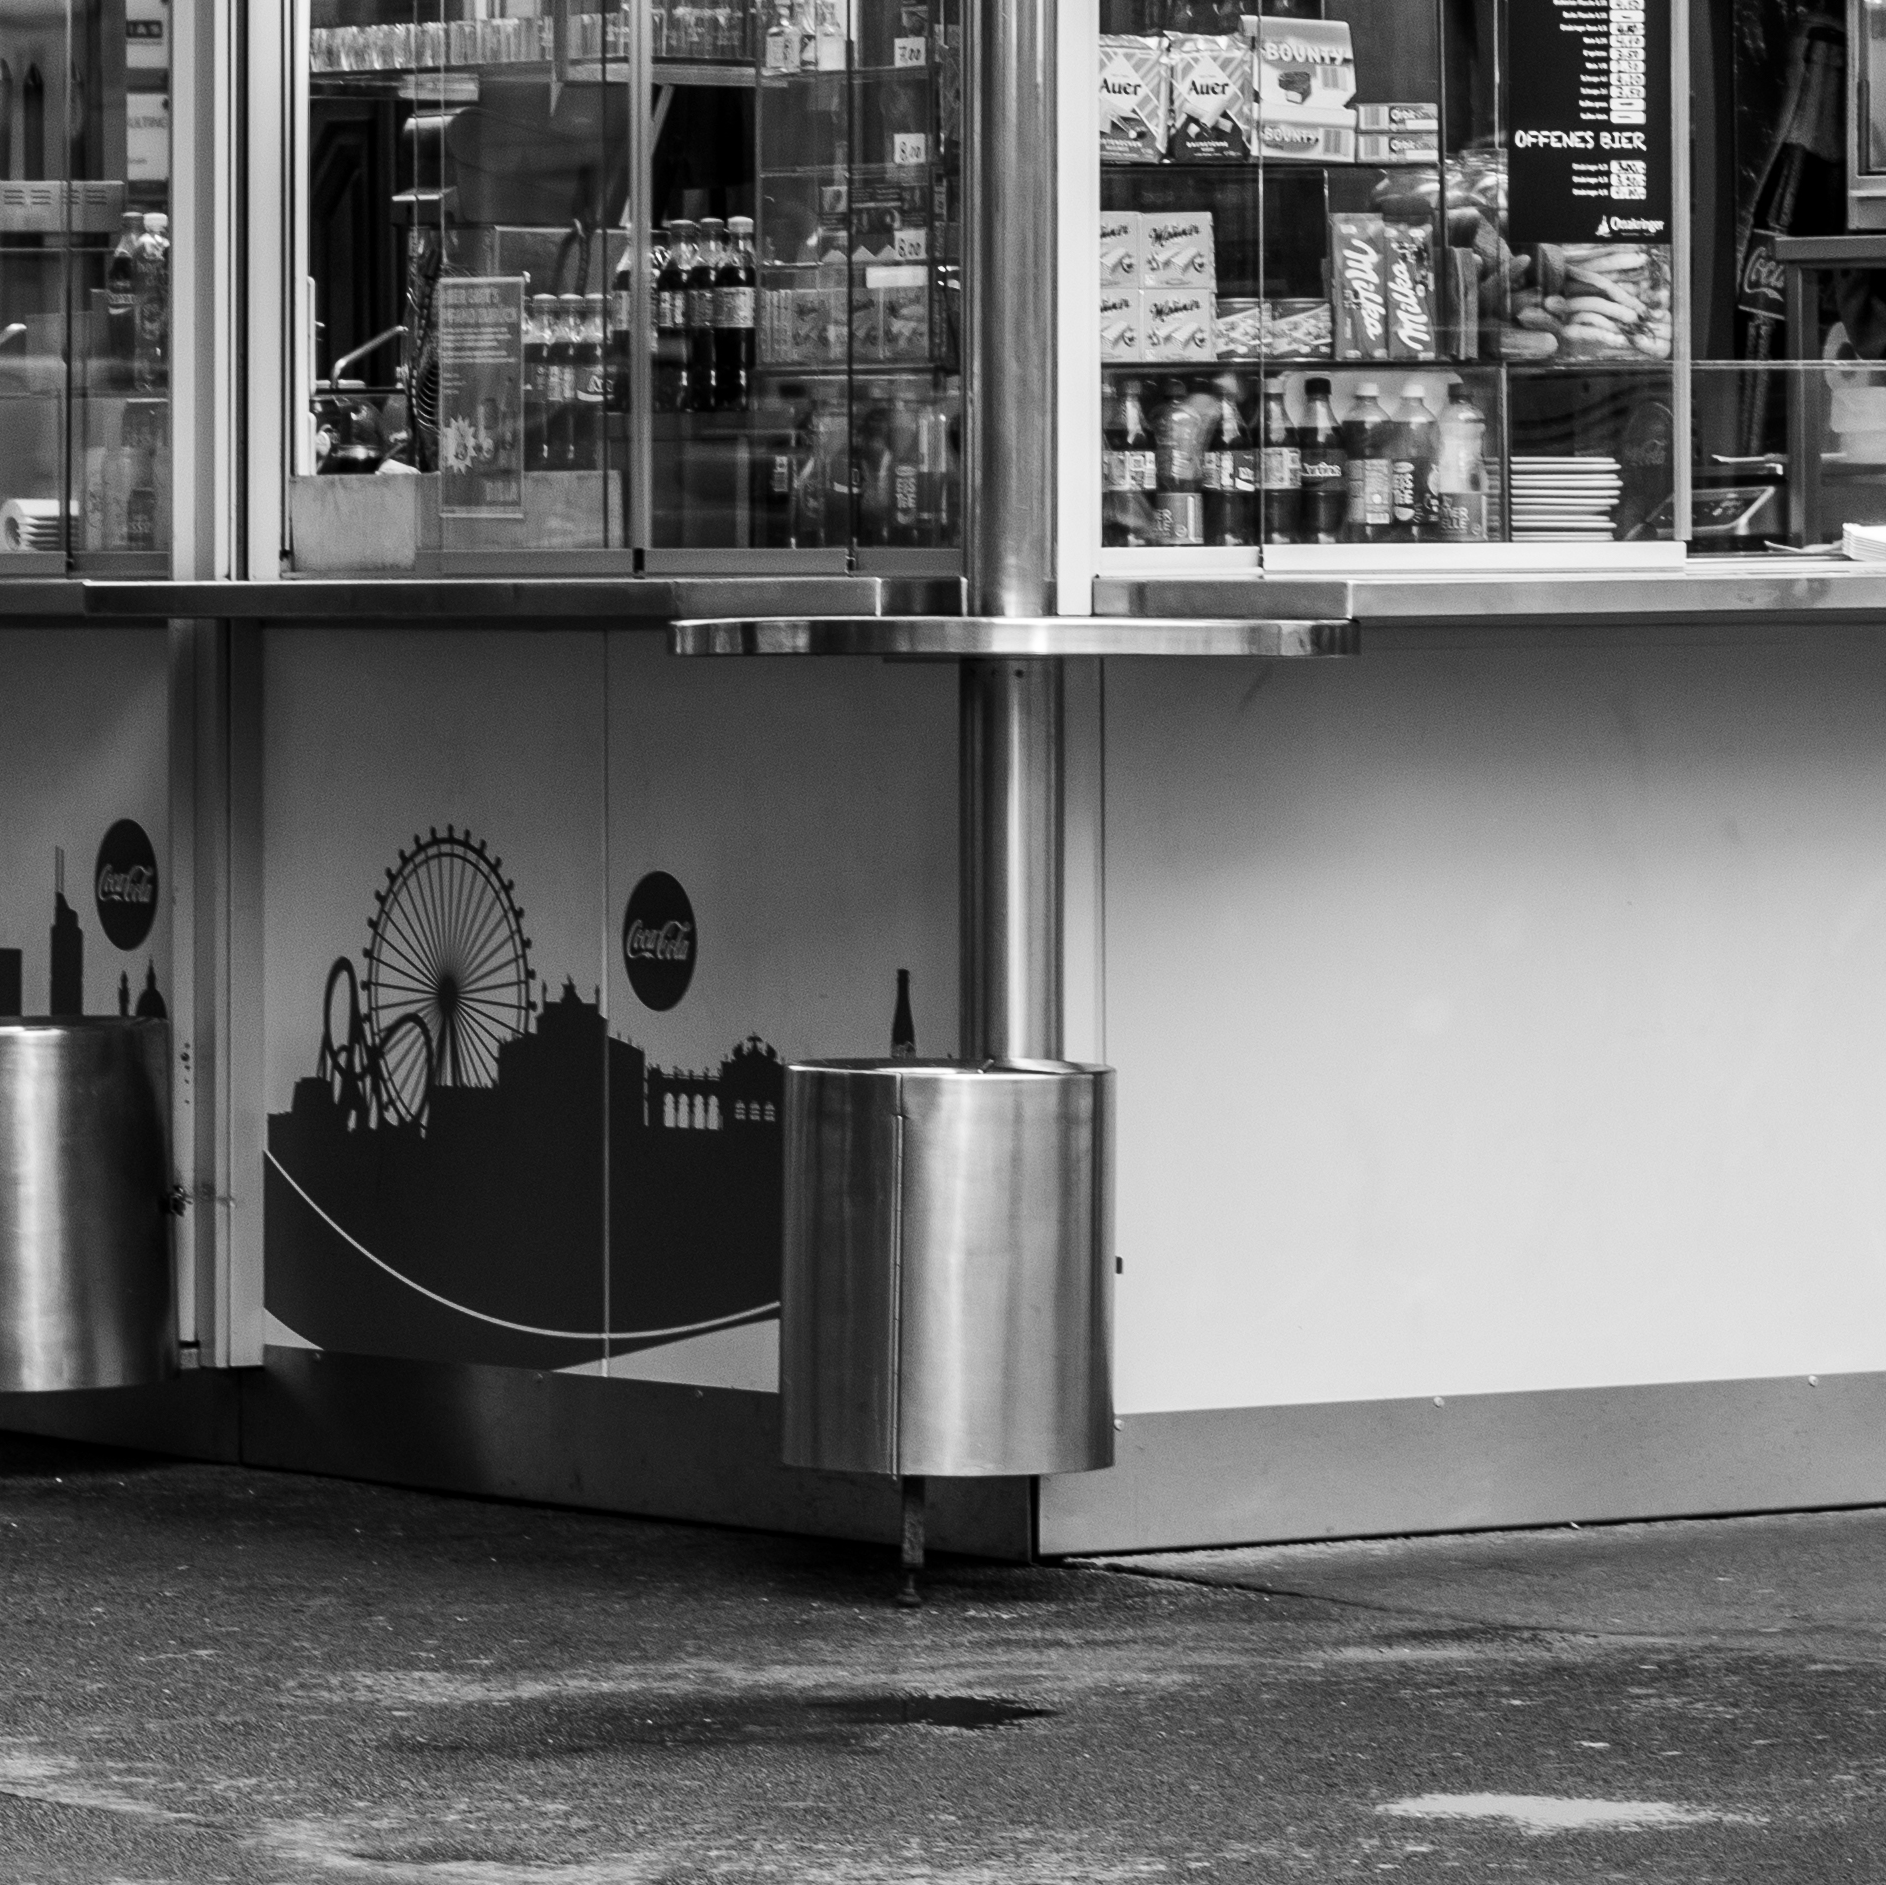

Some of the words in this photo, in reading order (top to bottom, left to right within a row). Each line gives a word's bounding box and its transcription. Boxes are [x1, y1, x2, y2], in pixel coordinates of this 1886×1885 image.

[1261, 41, 1345, 66] BOUNTY
[1101, 77, 1143, 96] Auer
[1188, 78, 1230, 96] Auer
[1261, 126, 1319, 144] BOUNTY
[1514, 129, 1595, 151] OFFENES
[1599, 130, 1647, 152] BIER
[1342, 237, 1387, 341] Milka
[1386, 257, 1431, 352] Milka
